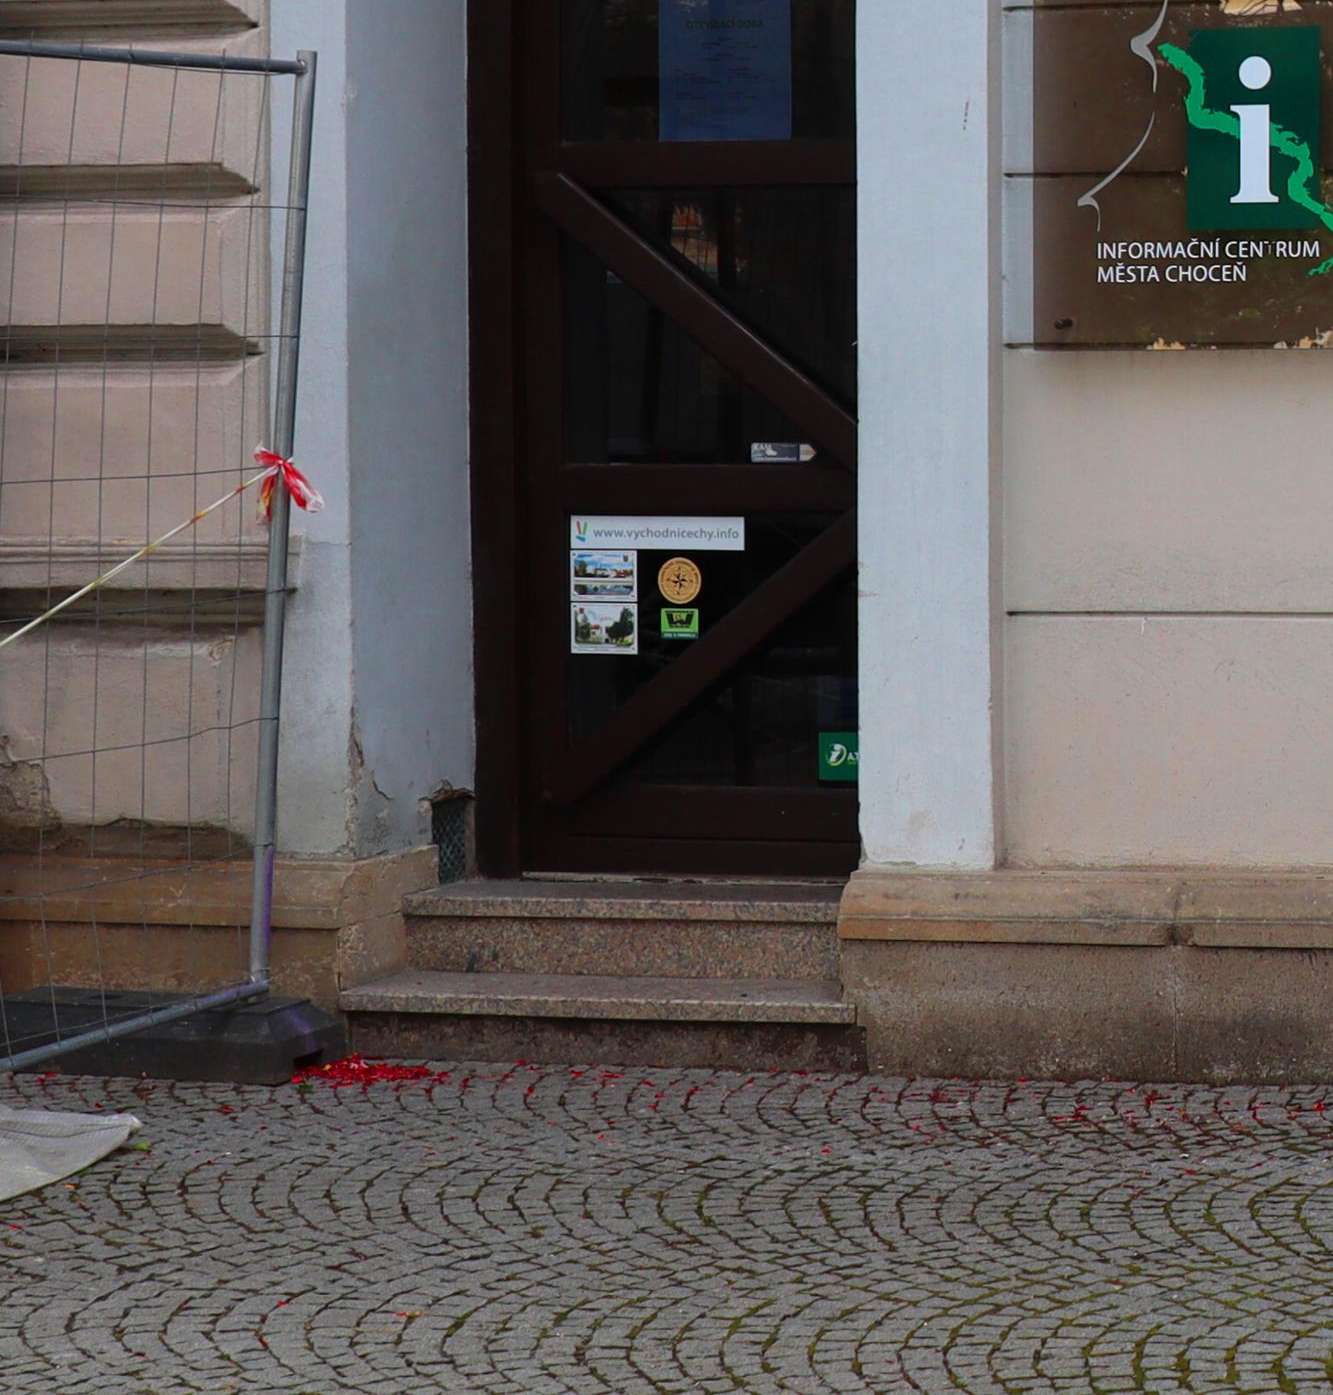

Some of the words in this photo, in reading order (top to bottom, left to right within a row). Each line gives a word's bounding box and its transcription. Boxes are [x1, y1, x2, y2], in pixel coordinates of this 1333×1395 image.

[1096, 237, 1221, 260] INFORMAČNÍ
[1096, 261, 1161, 284] MĚSTA
[1164, 260, 1247, 283] CHOCEŇ
[592, 527, 740, 541] www.vychodnicechy.info
